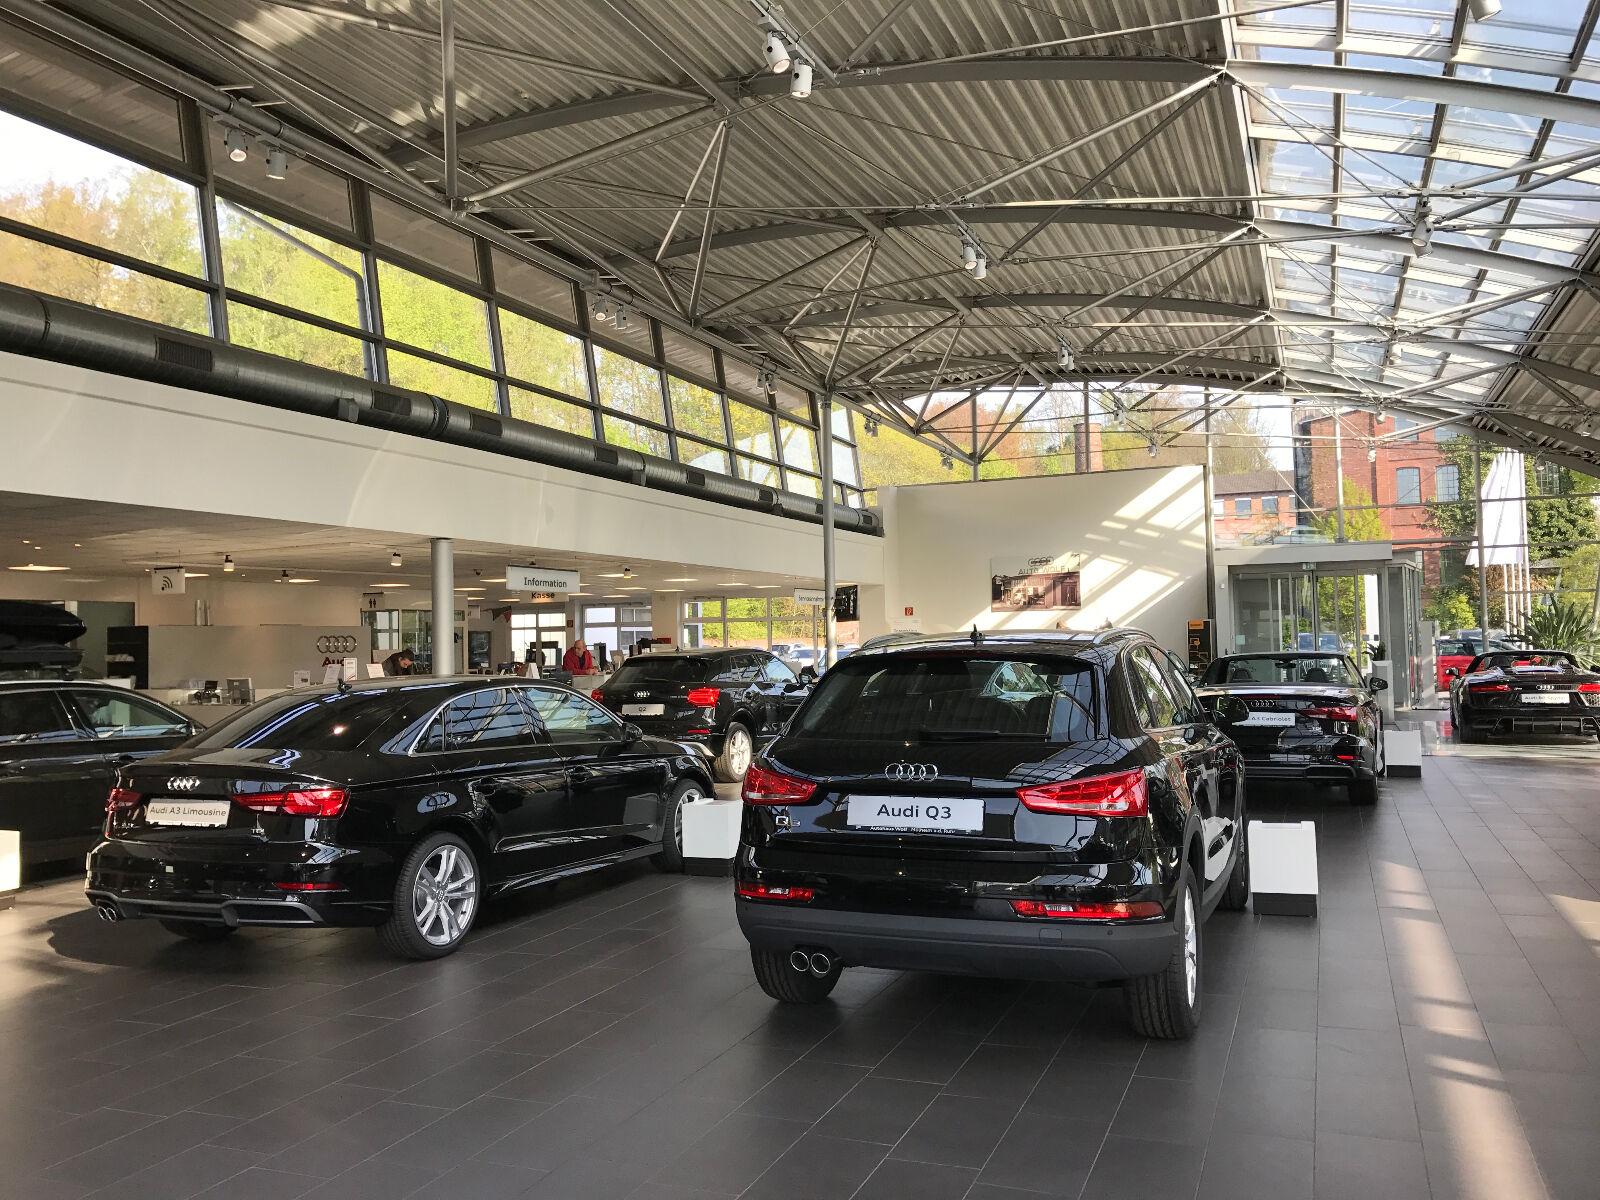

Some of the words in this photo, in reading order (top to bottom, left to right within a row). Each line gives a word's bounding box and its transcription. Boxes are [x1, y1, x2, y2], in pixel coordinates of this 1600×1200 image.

[524, 577, 567, 588] Information
[150, 806, 168, 814] Audi
[169, 806, 181, 815] A3
[182, 807, 227, 817] Limousine
[877, 803, 920, 818] Audi
[925, 805, 952, 820] Q3
